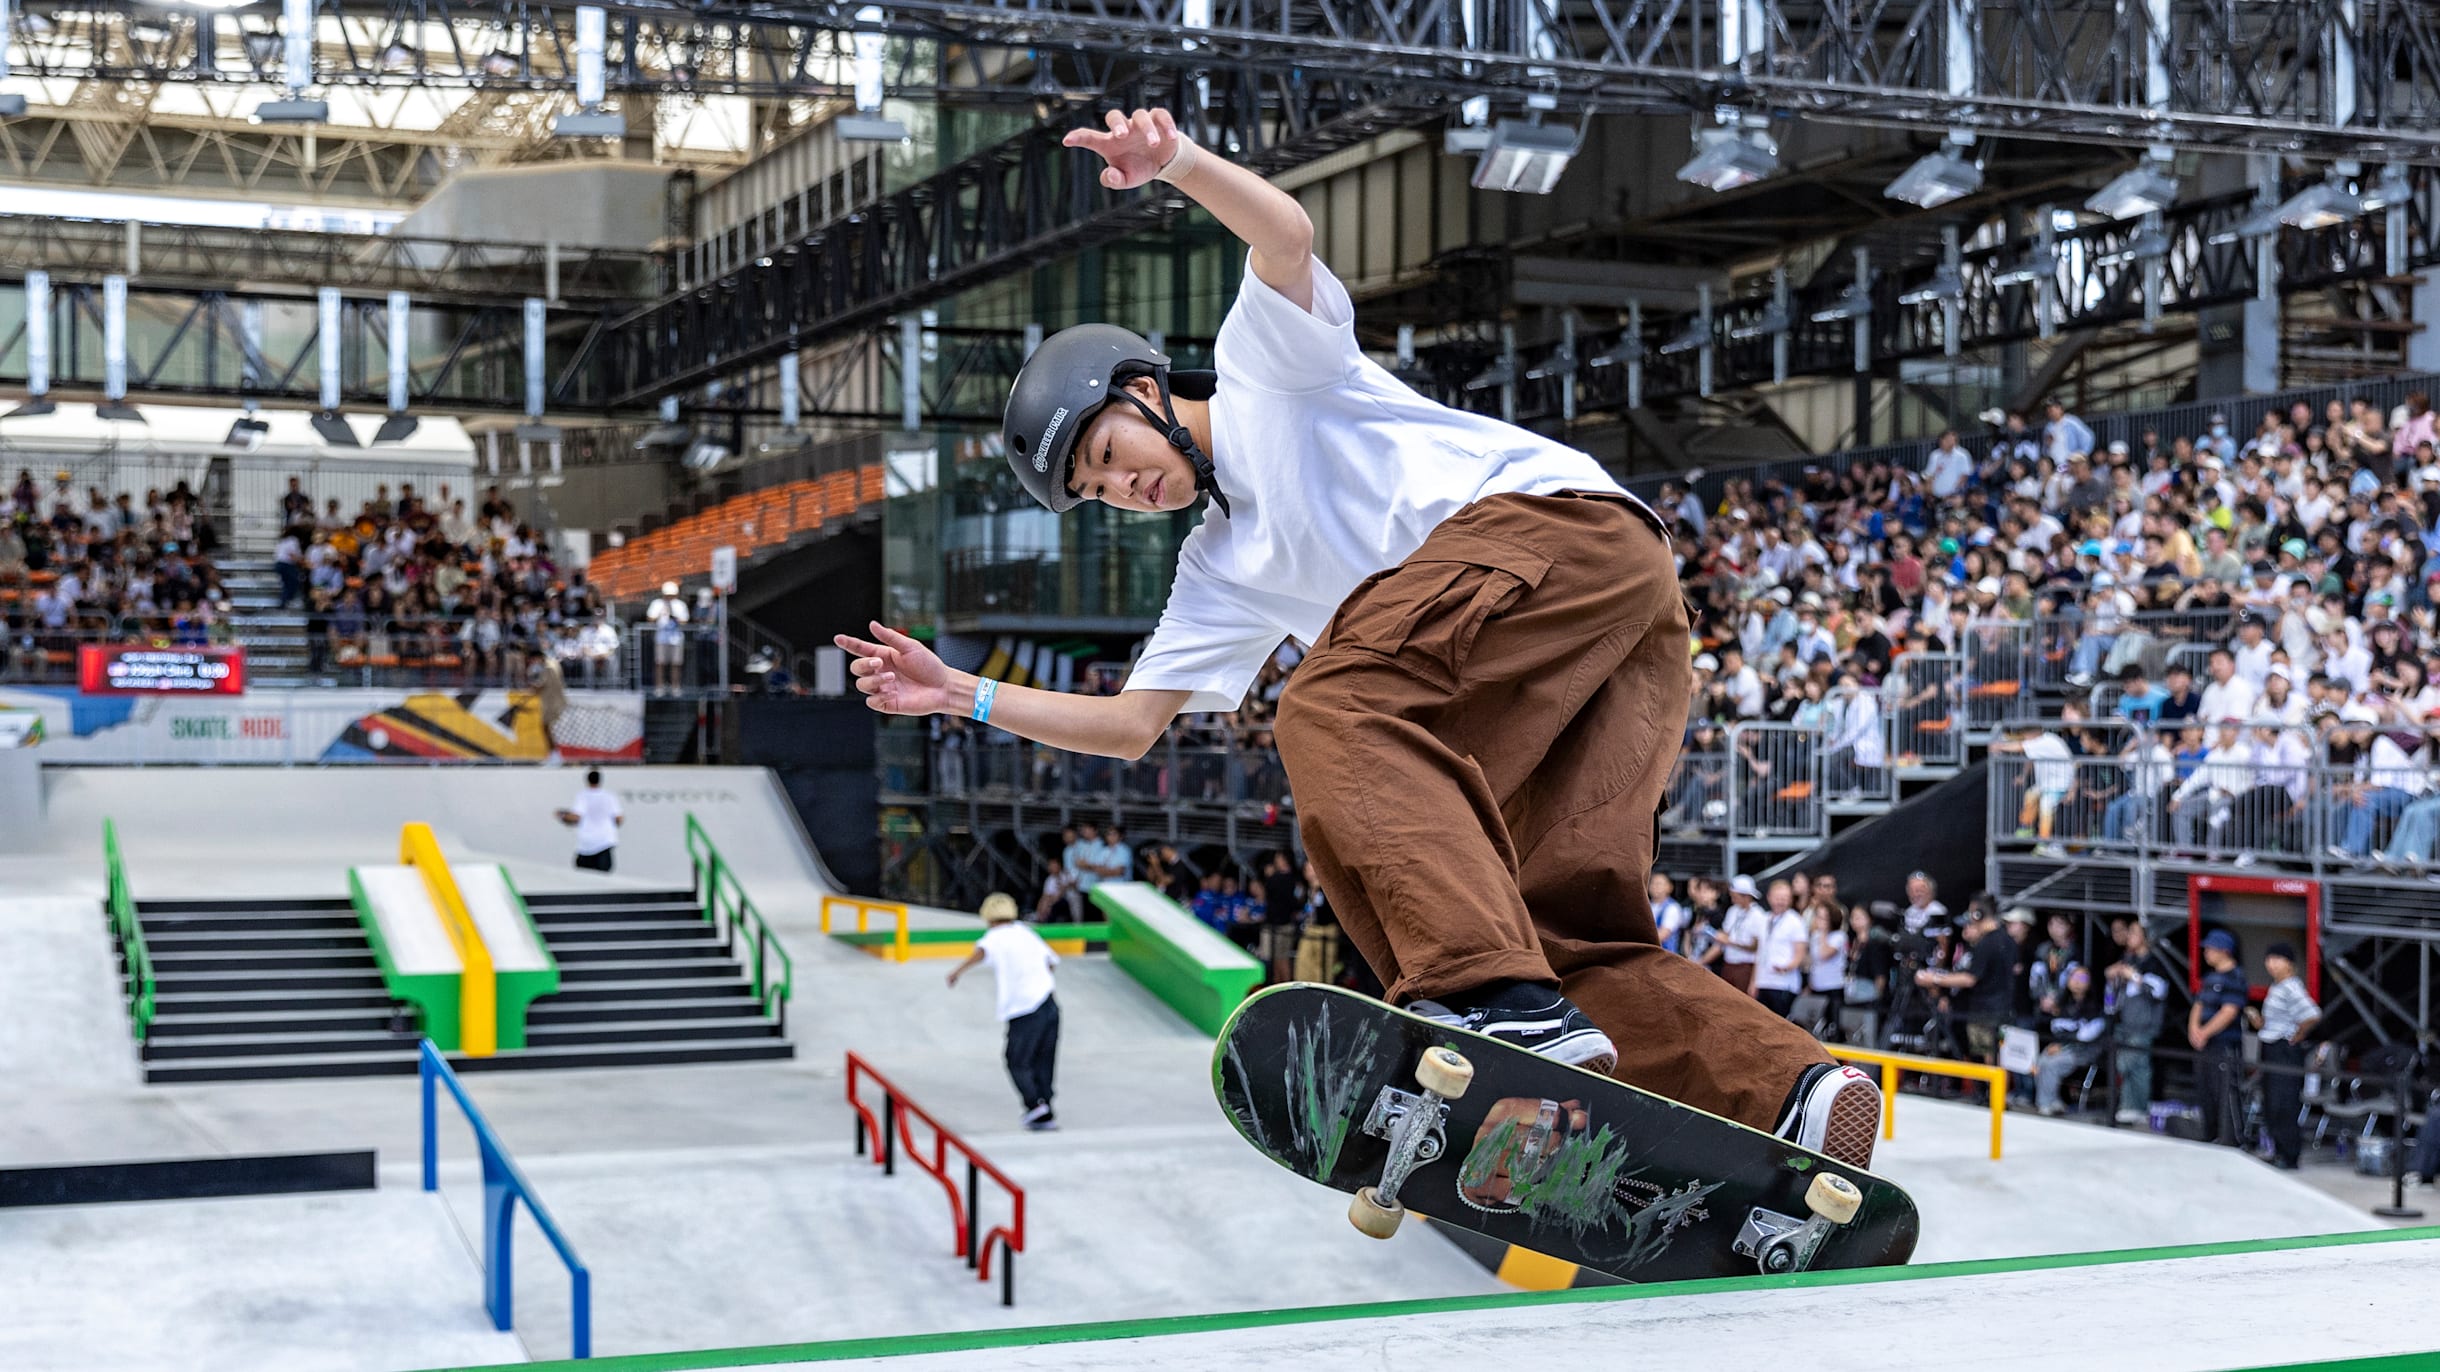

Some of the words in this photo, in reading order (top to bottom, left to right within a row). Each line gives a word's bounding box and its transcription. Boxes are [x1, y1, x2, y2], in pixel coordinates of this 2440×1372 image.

[1038, 428, 1056, 457] KILLER
[1049, 407, 1069, 431] PADS
[621, 788, 740, 803] TOYOTA
